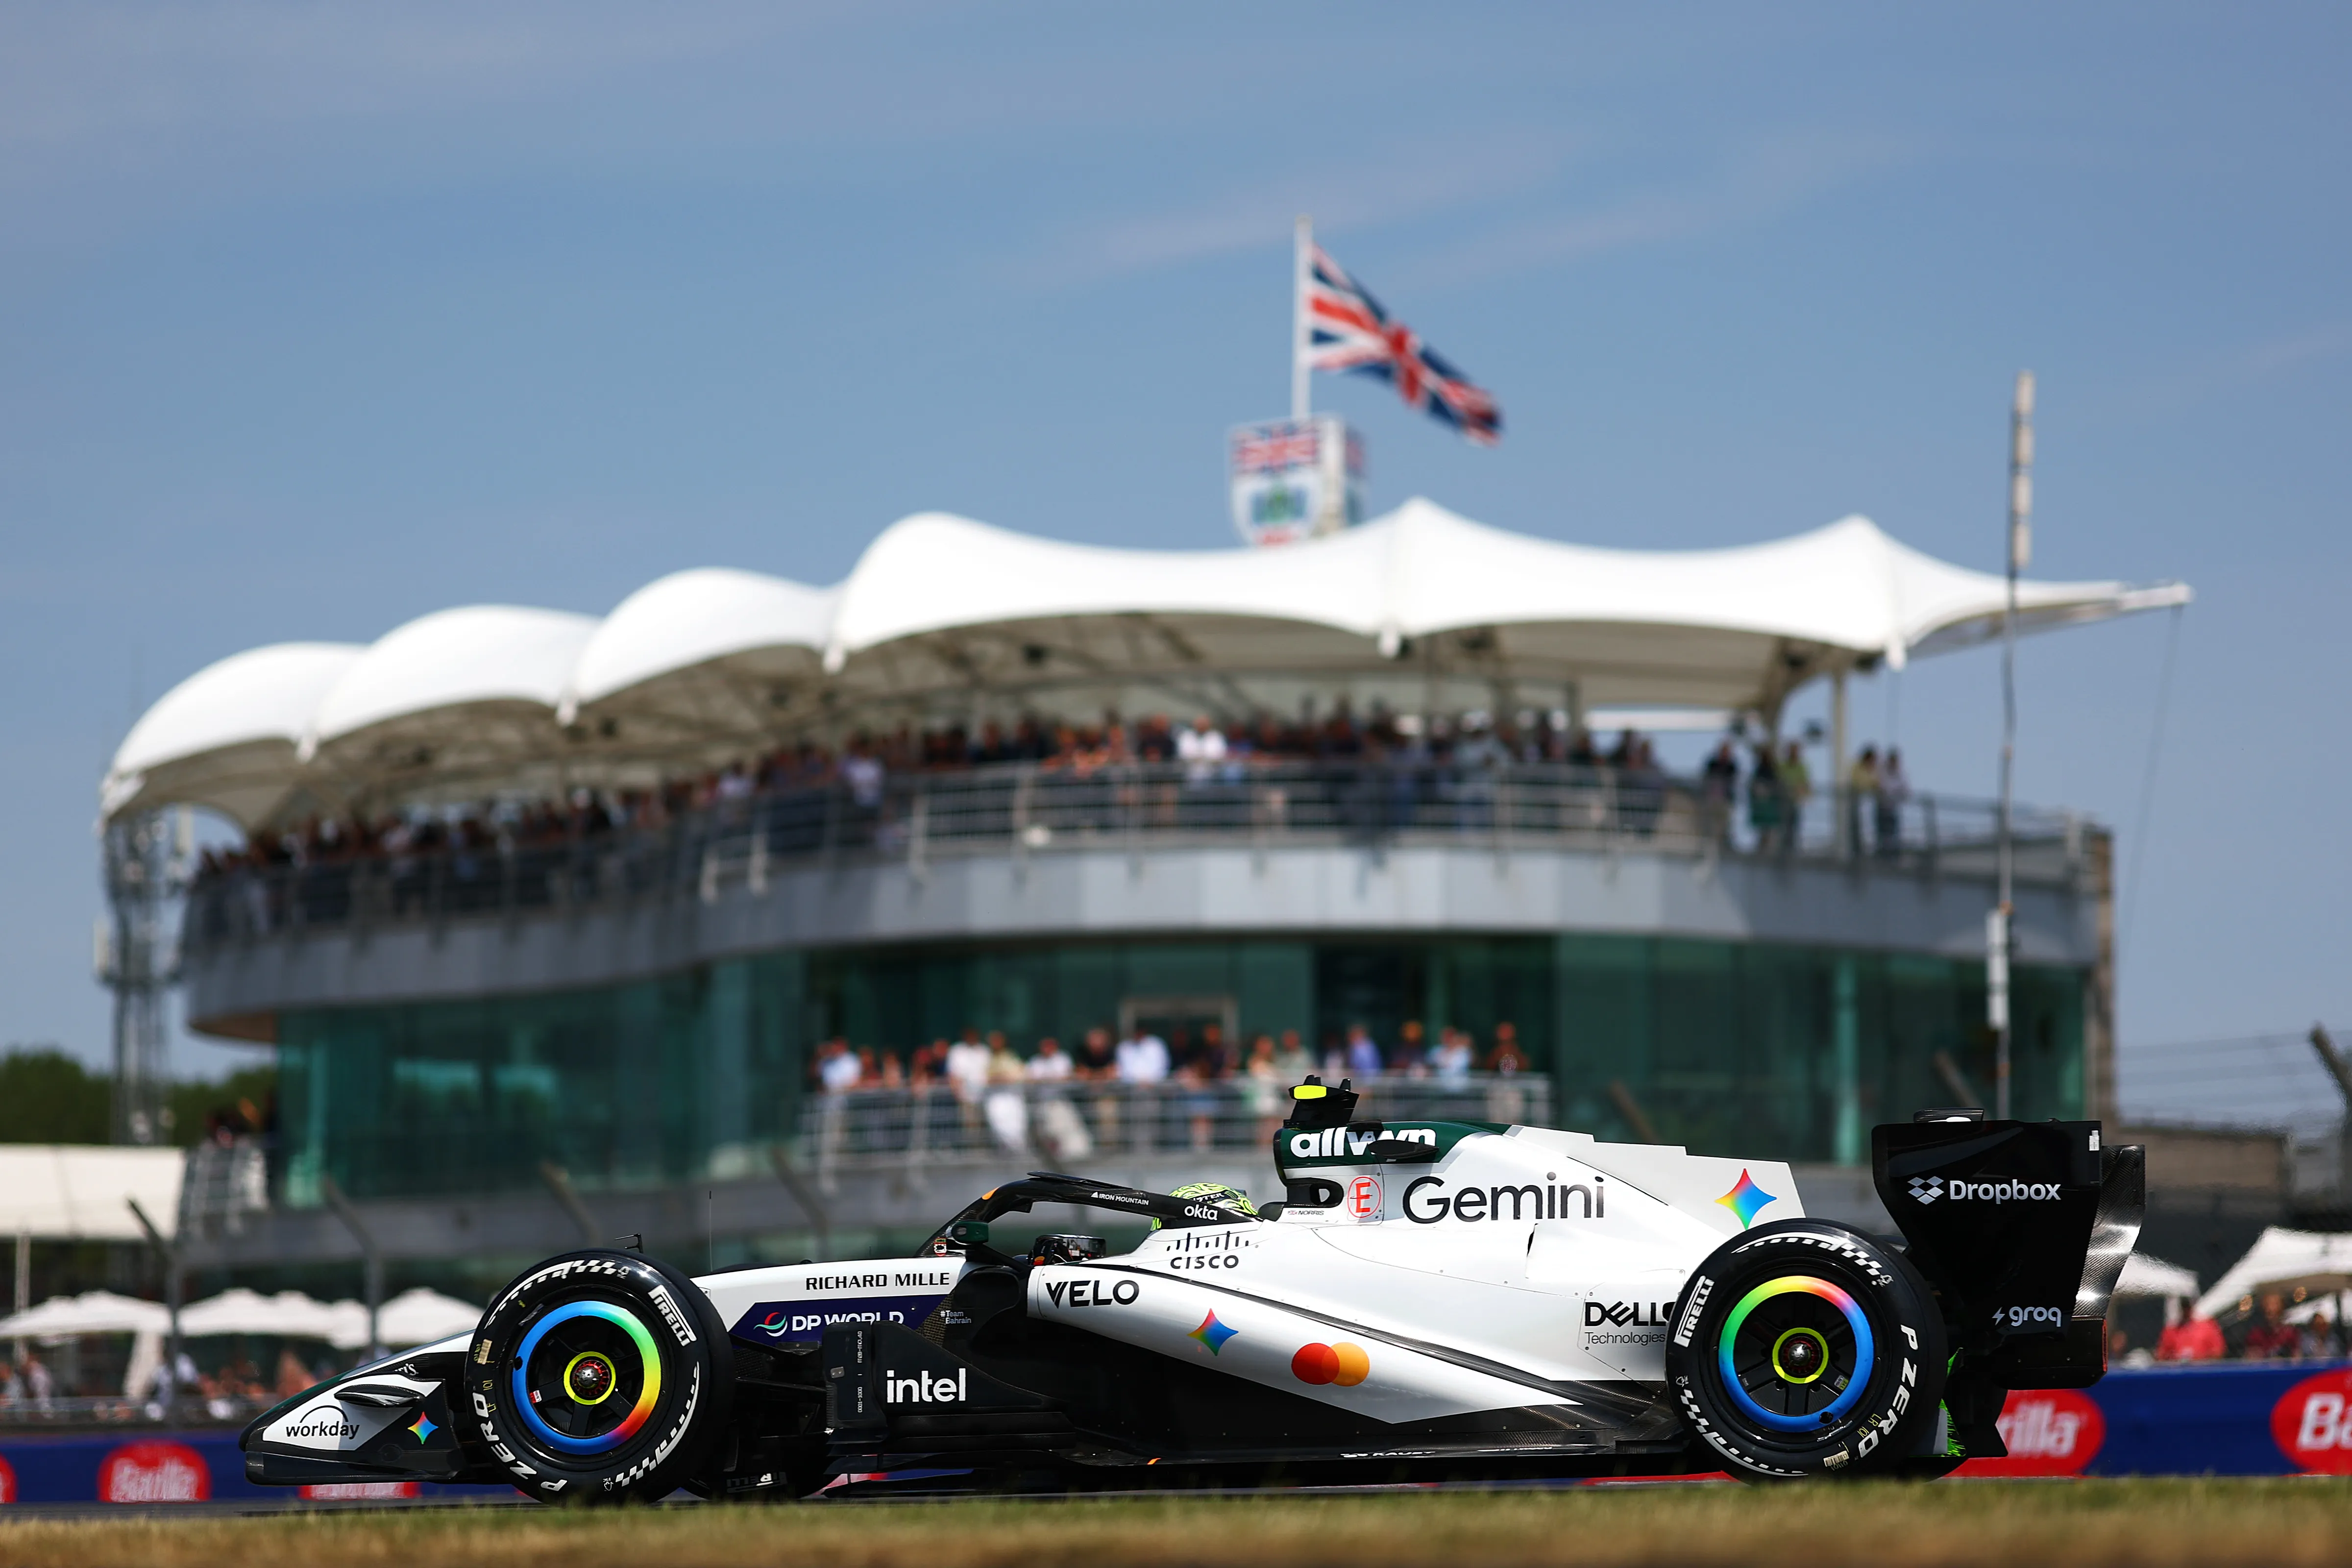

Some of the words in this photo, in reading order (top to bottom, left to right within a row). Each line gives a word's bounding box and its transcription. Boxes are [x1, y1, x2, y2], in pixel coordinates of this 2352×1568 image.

[1115, 1195, 1149, 1205] MOUNTAIN
[1355, 1181, 1371, 1213] E
[1402, 1171, 1604, 1224] Gemini
[1950, 1179, 2061, 1204] Dropbox
[1184, 1204, 1218, 1221] okta
[1171, 1255, 1239, 1269] CISCO
[805, 1274, 887, 1291] RICHARD
[895, 1272, 950, 1287] MILLE
[1046, 1280, 1140, 1308] VELO
[648, 1285, 697, 1347] PIRELLI
[792, 1315, 821, 1331] DP
[1585, 1301, 1666, 1327] DELL
[1673, 1275, 1715, 1348] PIRELLI
[2009, 1306, 2061, 1327] groq
[1585, 1332, 1666, 1346] Technologies
[1900, 1324, 1919, 1350] P
[887, 1368, 966, 1403] intel
[1858, 1357, 1917, 1458] ZERO
[286, 1421, 360, 1439] workday
[472, 1392, 537, 1480] ZERO
[540, 1479, 568, 1492] P
